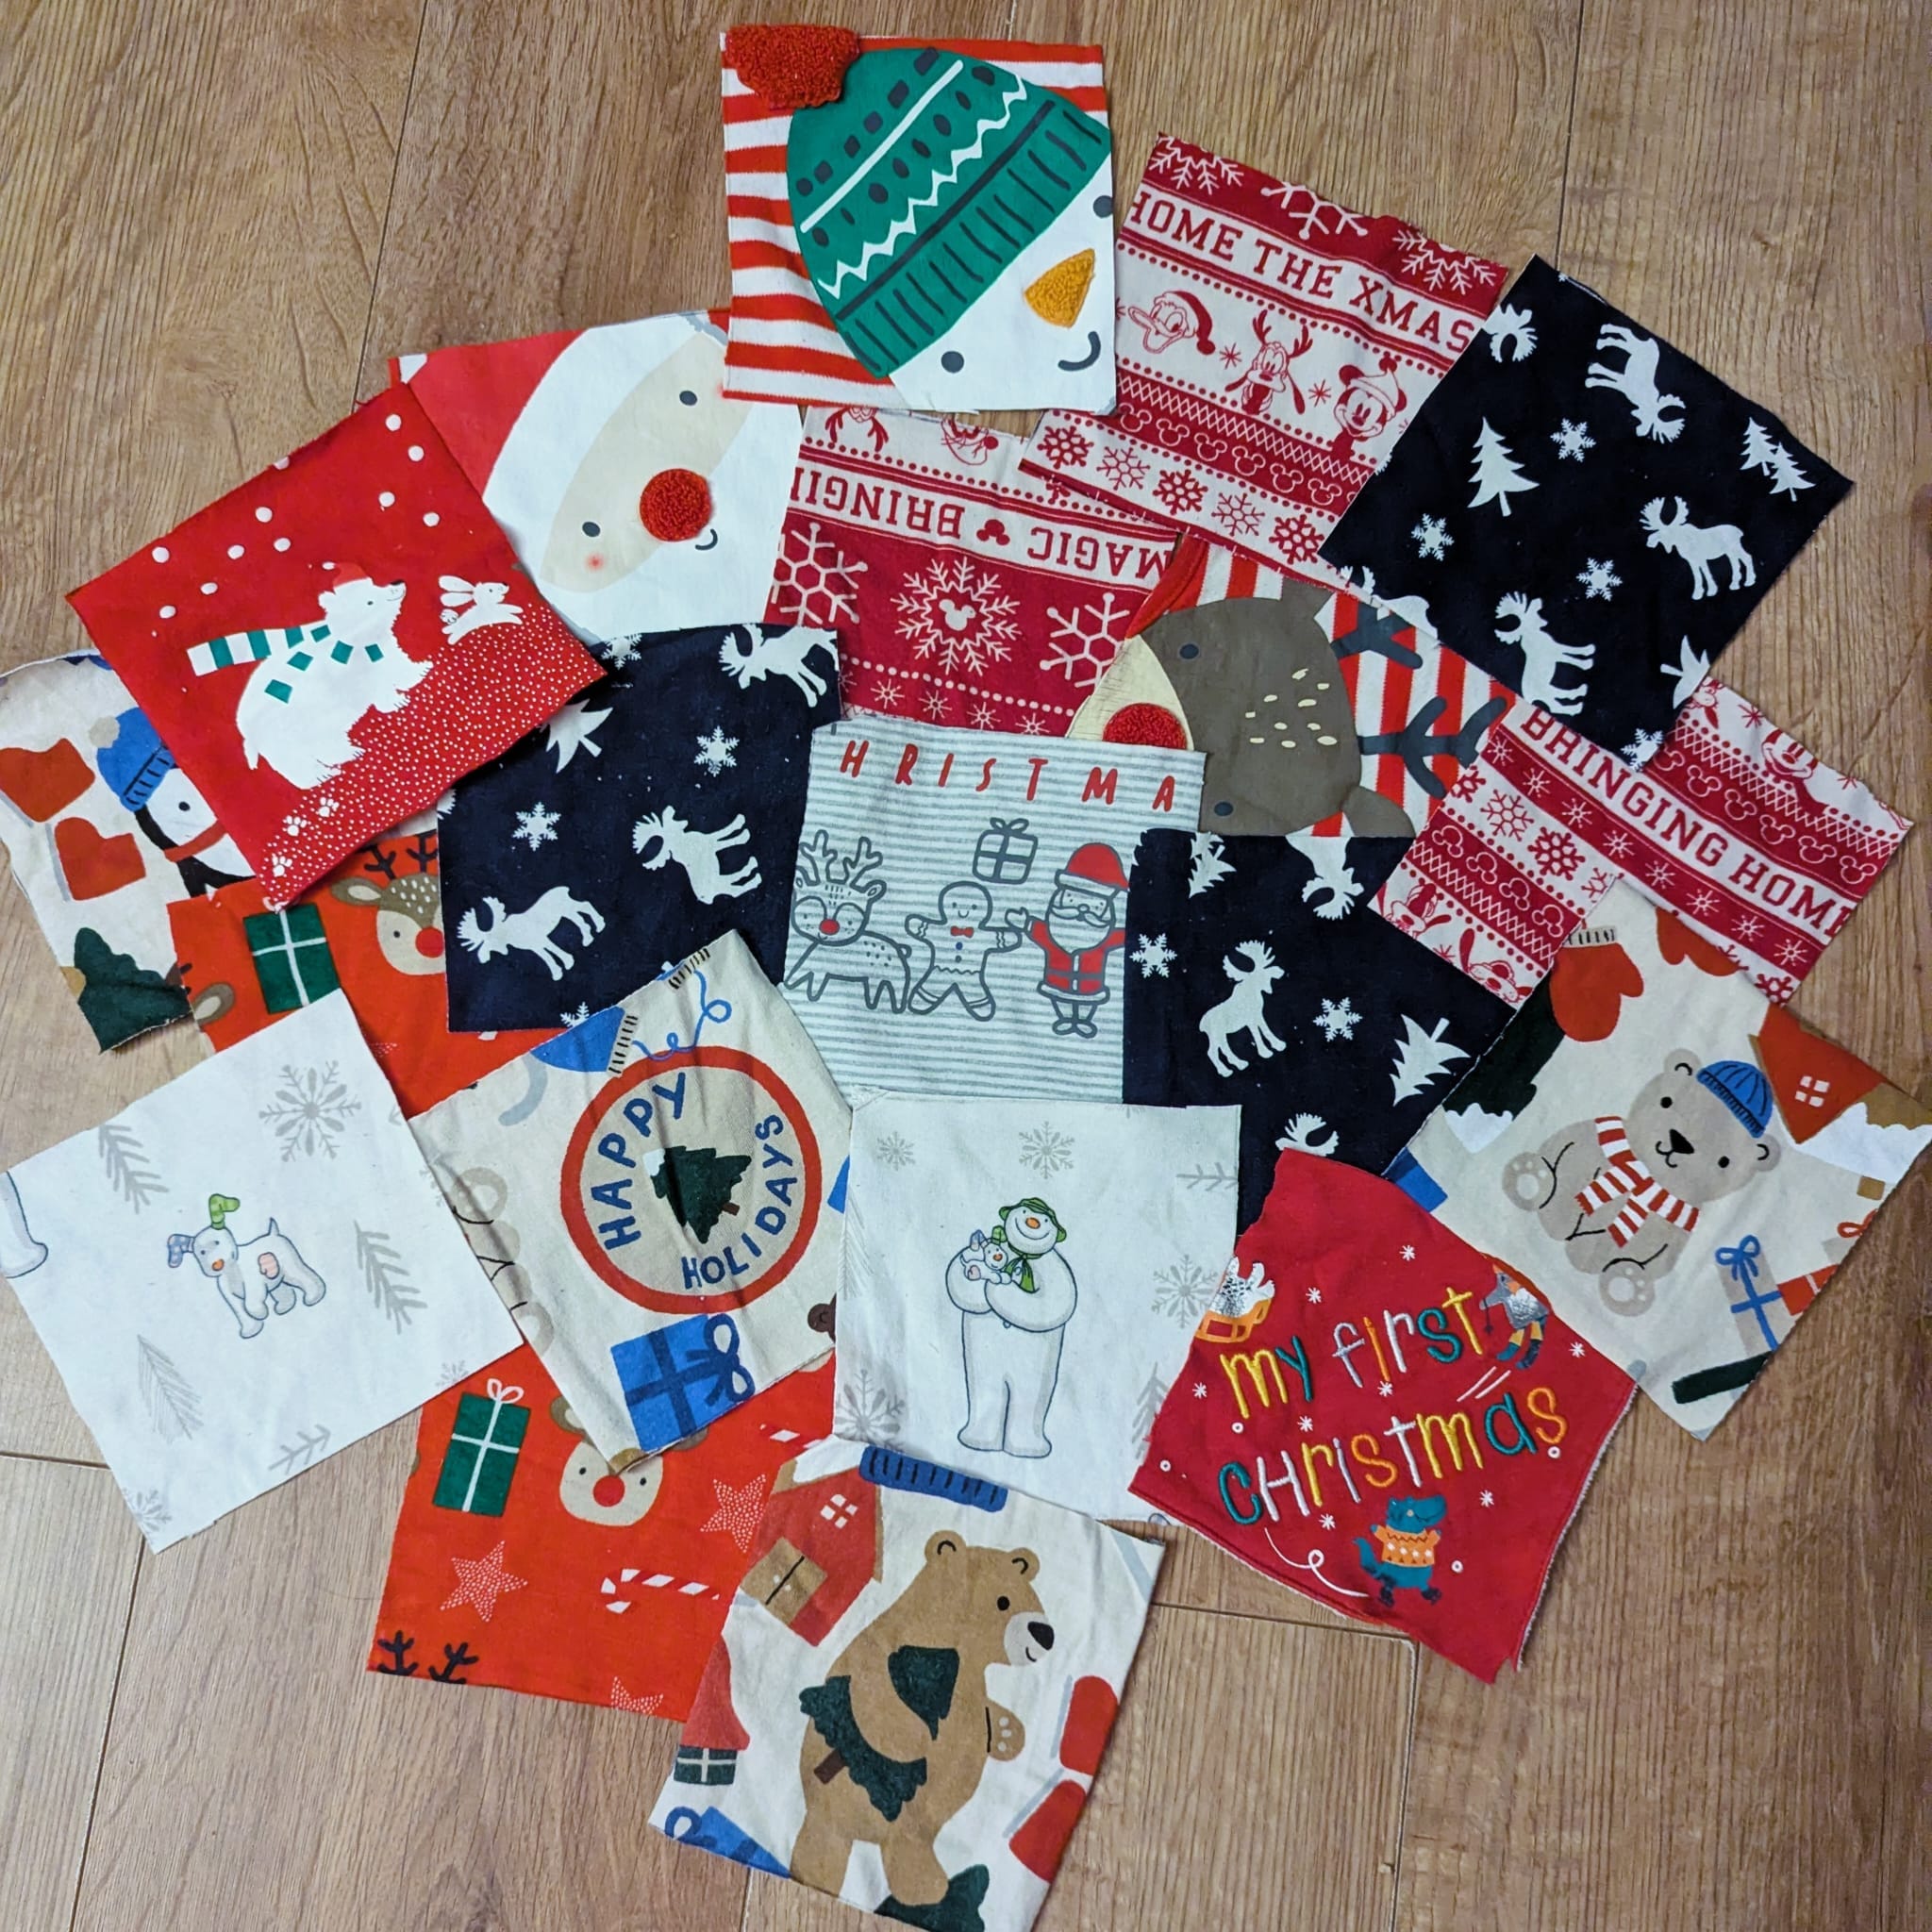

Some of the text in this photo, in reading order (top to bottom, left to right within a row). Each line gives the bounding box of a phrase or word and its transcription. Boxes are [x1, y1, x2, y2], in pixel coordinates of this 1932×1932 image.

[1256, 238, 1342, 299] THE
[1349, 275, 1475, 355] XMAS
[1026, 526, 1173, 580] MAGIC
[839, 740, 1175, 812] HRISTMA
[1520, 708, 1729, 867] BRINGING
[591, 1072, 686, 1251] HAPPY
[681, 1114, 798, 1290] HOLIDAYS
[1220, 1286, 1484, 1419] my first
